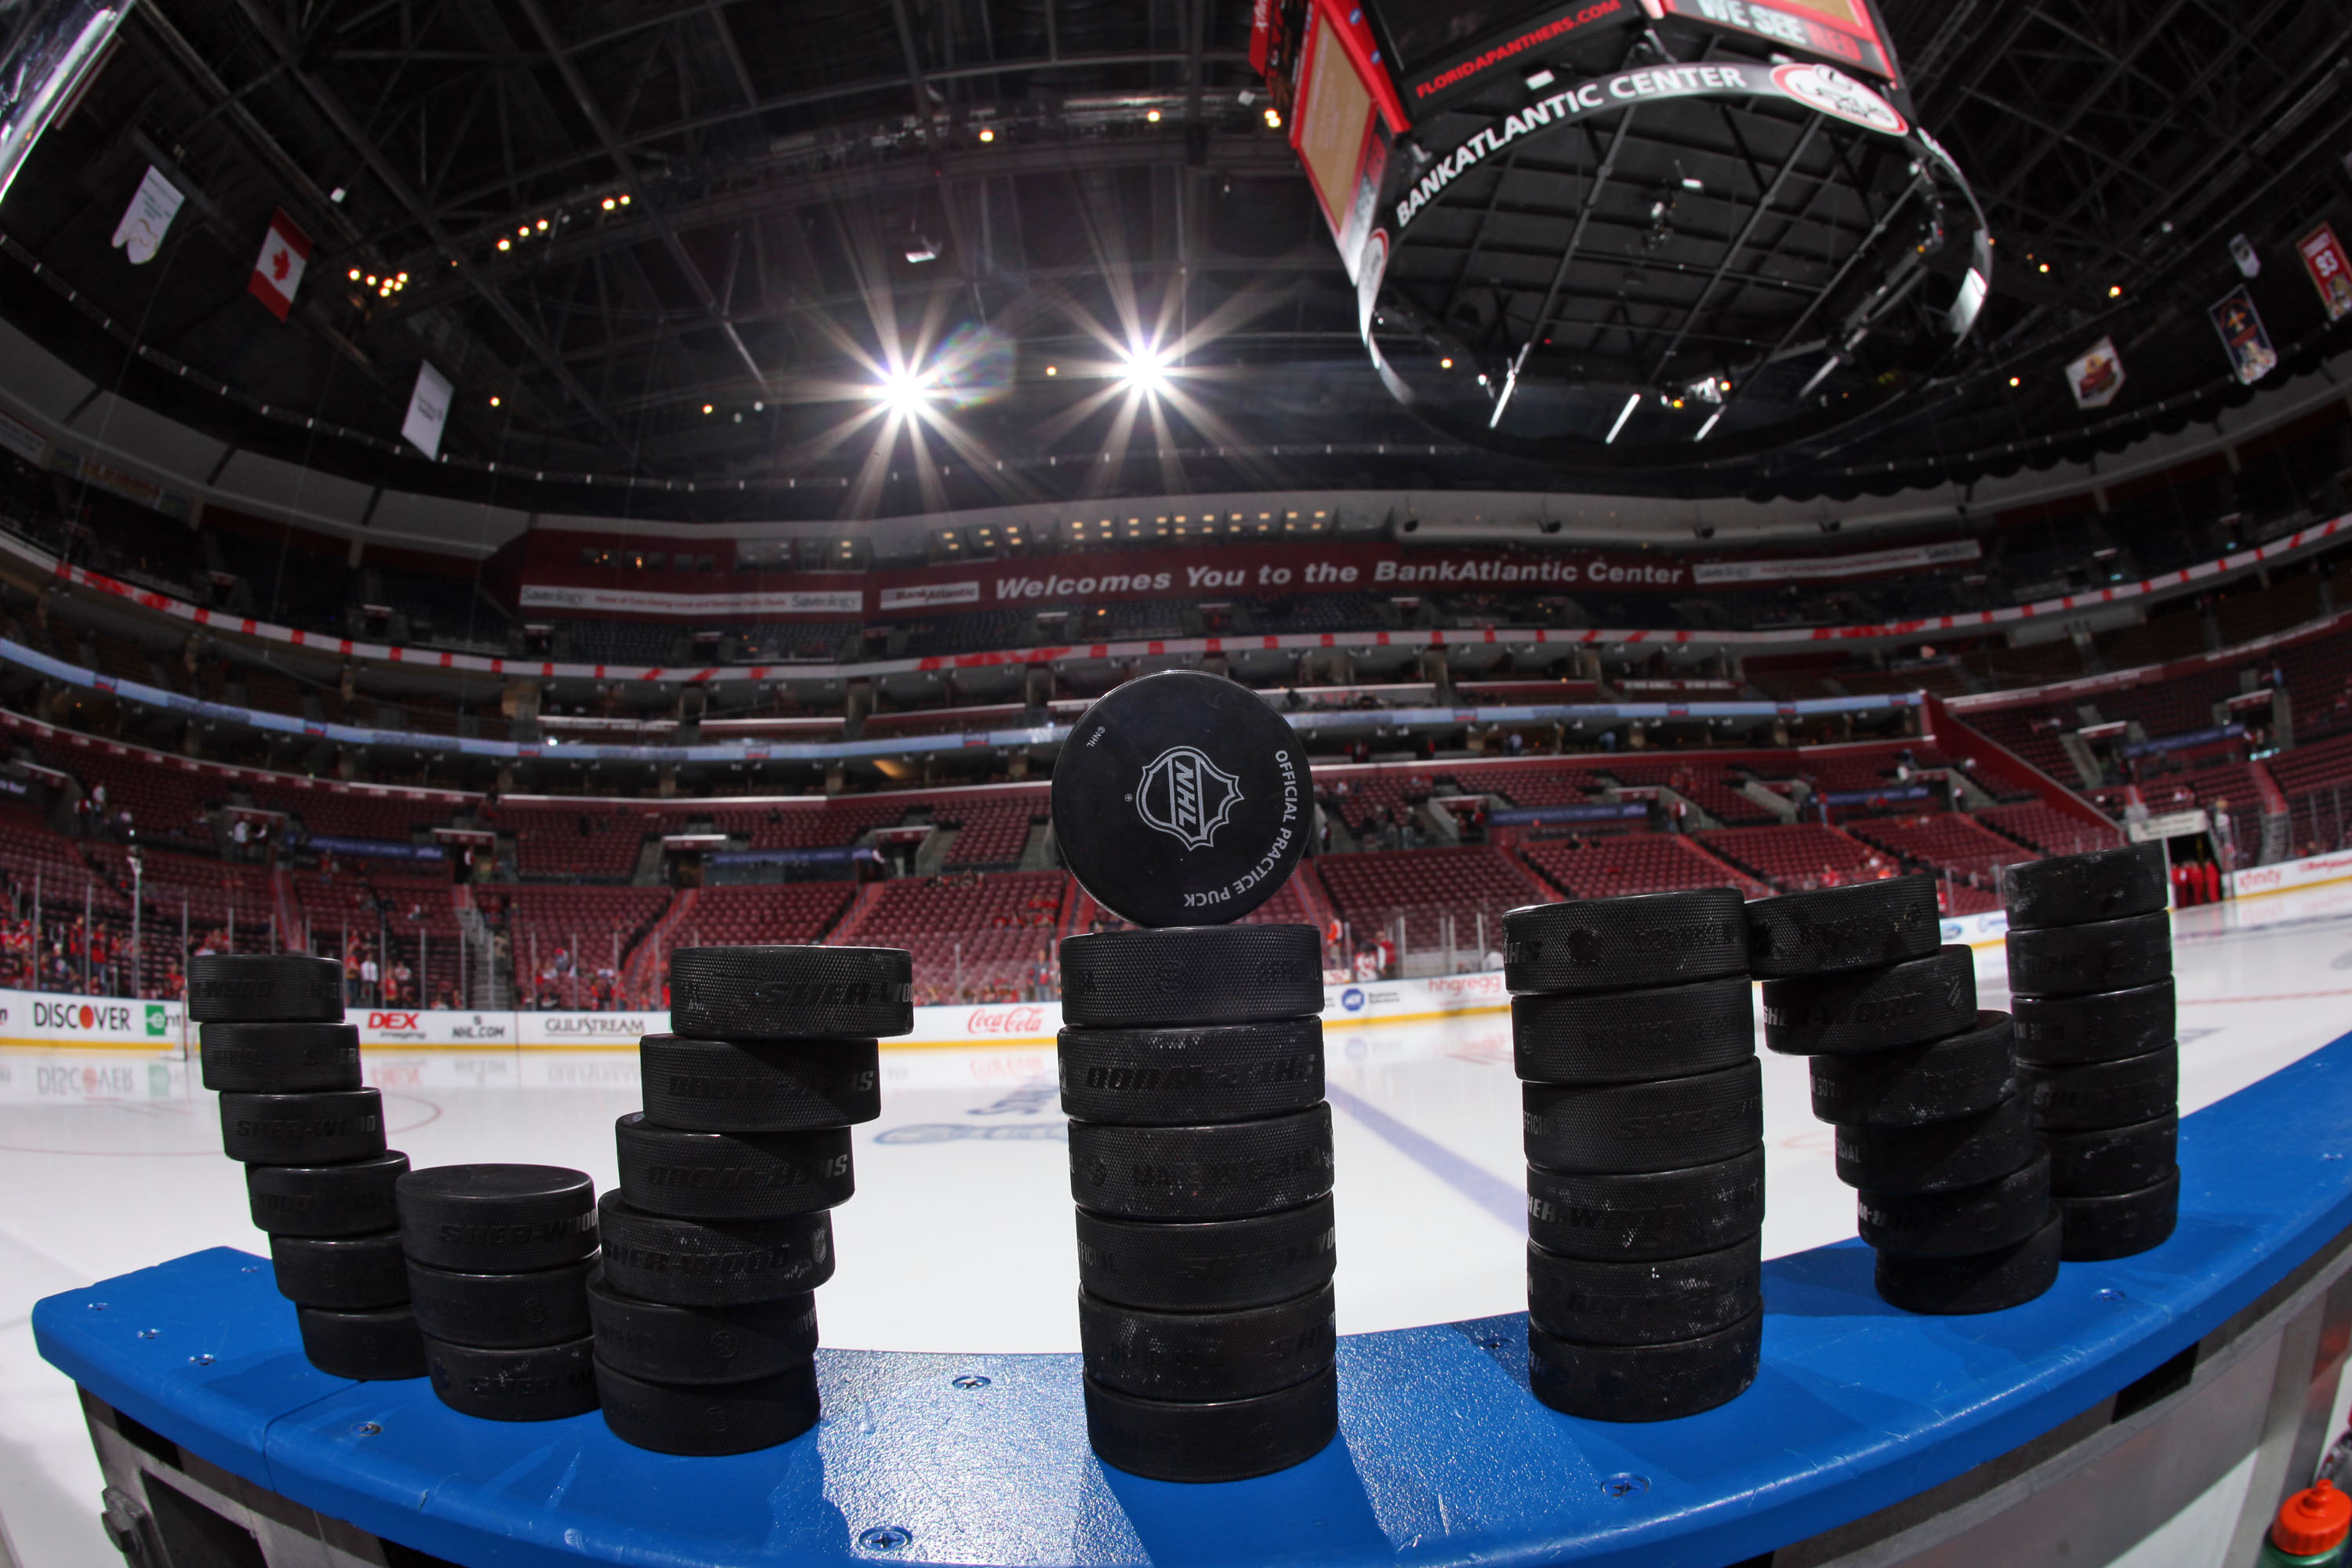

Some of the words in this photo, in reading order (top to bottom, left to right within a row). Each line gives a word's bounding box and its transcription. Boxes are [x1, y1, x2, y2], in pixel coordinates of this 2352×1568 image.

[1749, 3, 1807, 45] SEE
[1415, 0, 1622, 100] FLORIDAPANTHERS.COM
[1396, 82, 1605, 227] BANKATLANTIC
[1610, 65, 1747, 99] CENTER
[996, 570, 1171, 600] Welcomes
[1187, 564, 1245, 588] You
[1258, 562, 1293, 585] to
[1305, 561, 1359, 583] the
[1374, 559, 1579, 584] BankAtlantic
[1587, 560, 1684, 585] Center
[1175, 760, 1197, 827] NHL
[1275, 750, 1298, 823] OFFICIAL
[1235, 827, 1293, 895] PRACTICE
[1183, 886, 1232, 907] PUCK
[1428, 975, 1502, 996] hhgregg
[34, 1002, 131, 1031] DISCOVER
[367, 1012, 419, 1029] DEX
[451, 1026, 506, 1040] NHL.COM
[544, 1017, 646, 1034] GULFSTREAM
